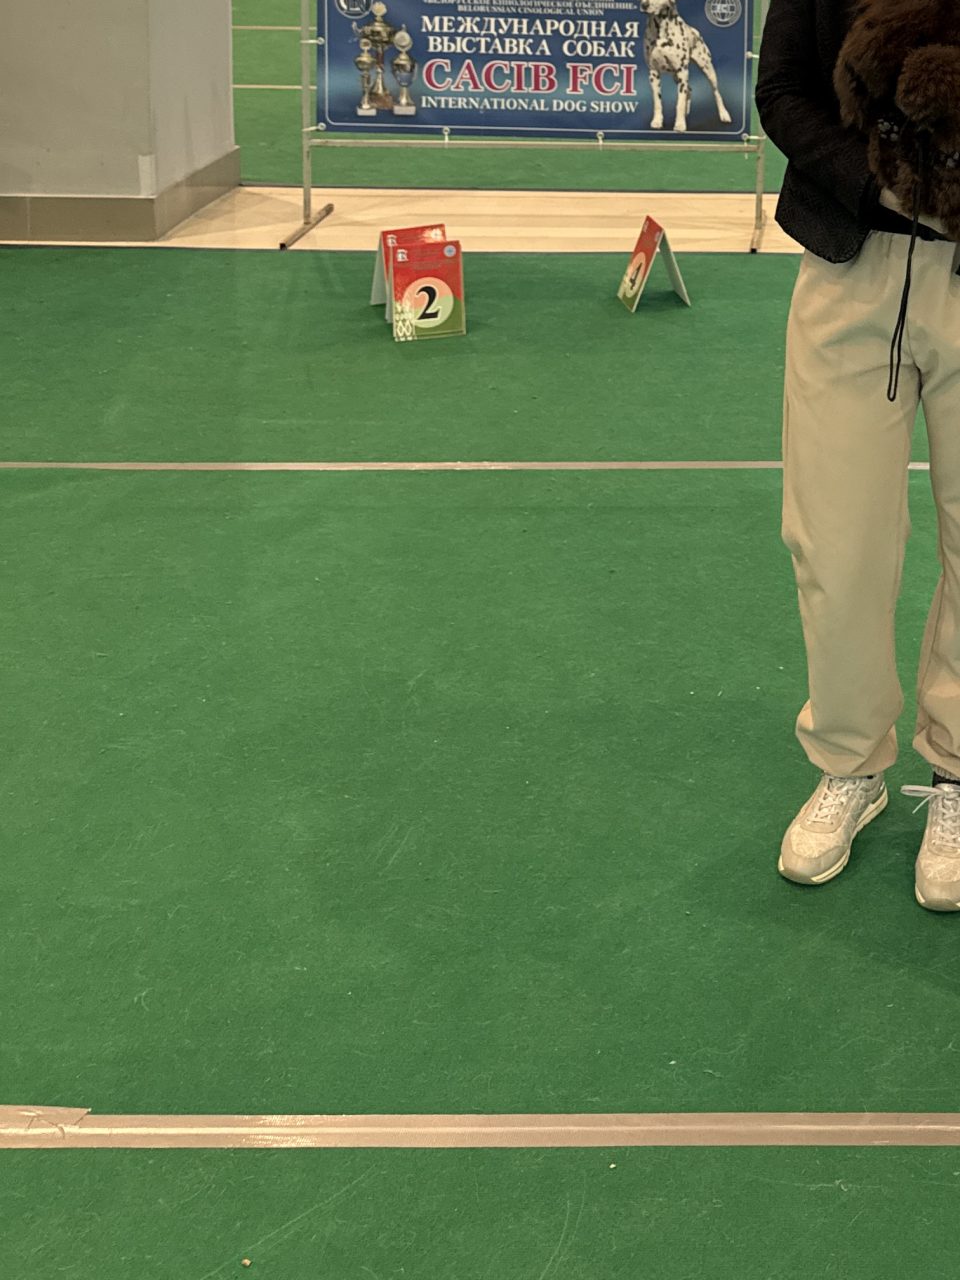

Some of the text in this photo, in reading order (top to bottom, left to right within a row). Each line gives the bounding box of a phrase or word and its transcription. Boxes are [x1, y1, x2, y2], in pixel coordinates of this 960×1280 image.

[577, 8, 604, 17] UNION
[421, 15, 639, 38] МЕЖДУНАРОДНАЯ
[428, 36, 636, 58] ВЫСТАВКА СОБАК
[422, 58, 637, 96] CACIB FCI
[421, 95, 639, 114] INTERNATIONAL DOG SHOW
[416, 285, 439, 321] 2
